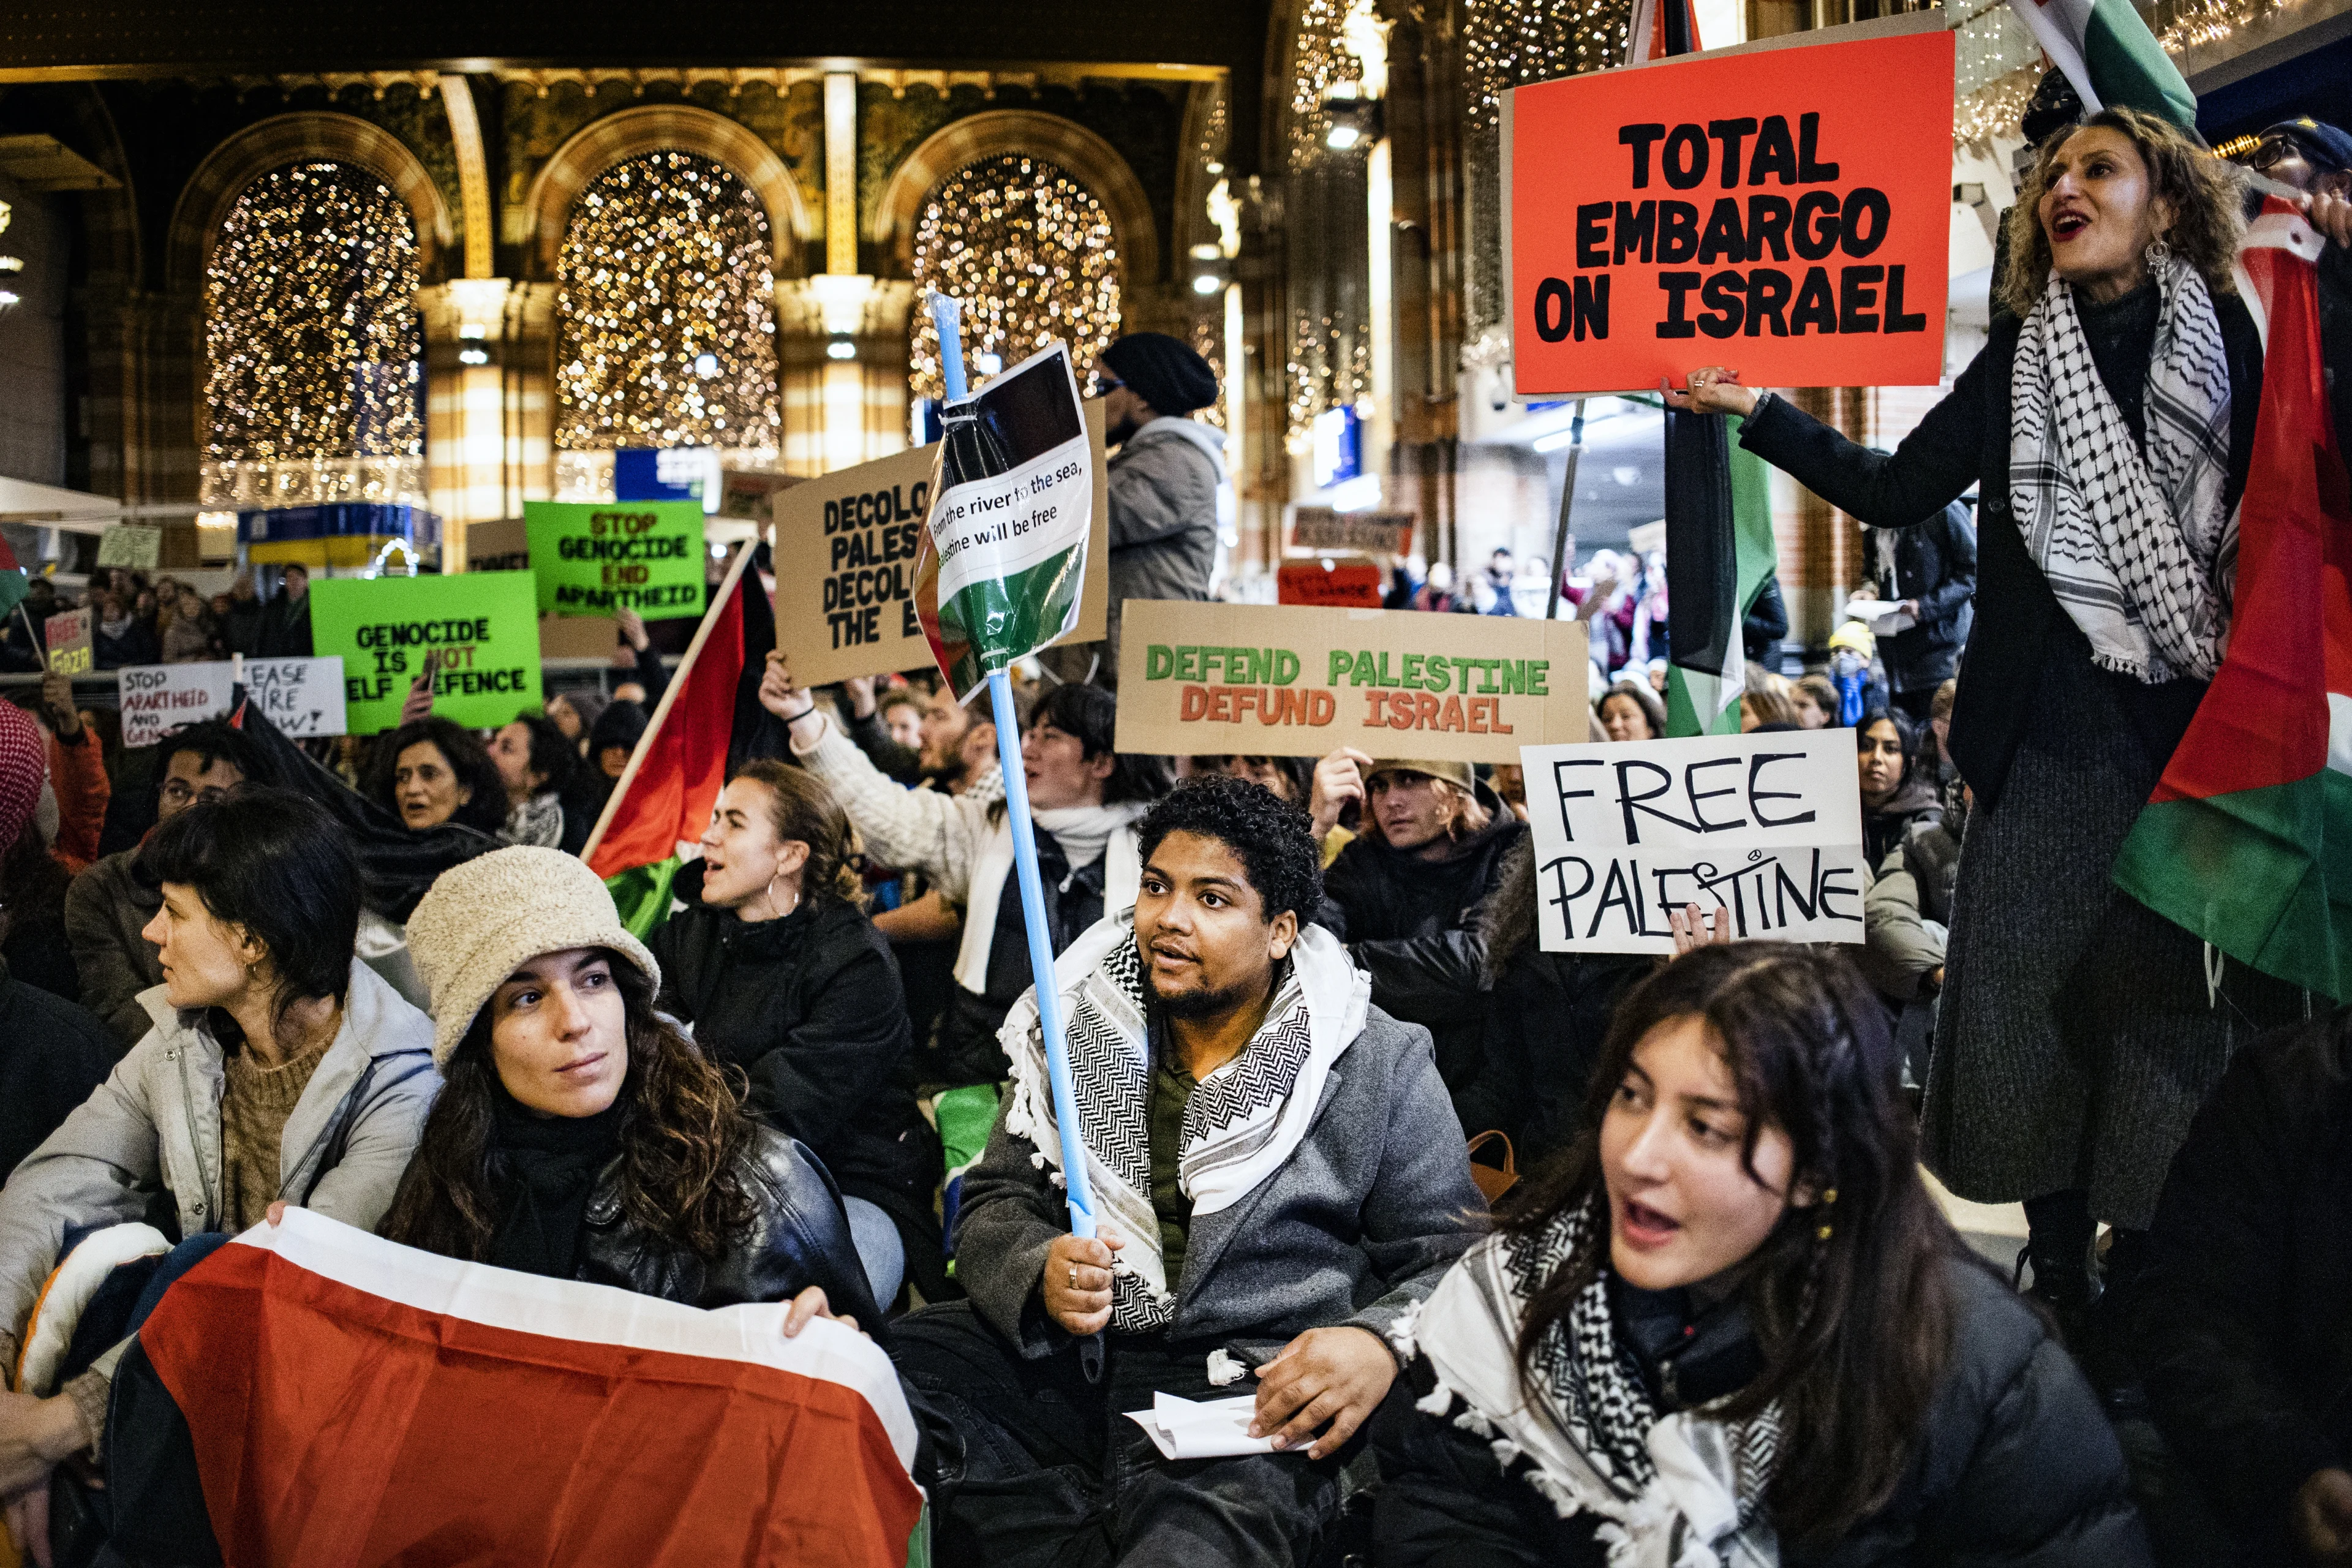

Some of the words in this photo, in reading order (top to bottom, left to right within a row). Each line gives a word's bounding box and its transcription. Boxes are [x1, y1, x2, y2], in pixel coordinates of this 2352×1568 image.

[1619, 112, 1839, 190] TOTAL
[1577, 187, 1891, 268] EMBARGO
[1534, 274, 1610, 342] ON
[1656, 265, 1926, 339] ISRAEL
[824, 481, 927, 536] DECOLO
[933, 518, 946, 540] From
[946, 505, 965, 525] the
[970, 493, 1011, 514] river
[1014, 486, 1028, 502] to
[1031, 474, 1053, 494] the
[1056, 462, 1082, 483] sea,
[590, 511, 658, 535] STOP
[974, 522, 1008, 545] will
[1012, 519, 1030, 537] be
[1032, 506, 1057, 529] free
[559, 534, 689, 560] GENOCIDE
[831, 523, 920, 571] PALES
[601, 564, 650, 585] END
[556, 584, 697, 607] APARTHEID
[45, 617, 79, 647] FREE
[356, 617, 490, 649] GENOCIDE
[827, 606, 881, 649] THE
[50, 647, 89, 674] GAZA
[243, 663, 307, 687] EASE
[374, 650, 407, 673] IS
[1145, 644, 1300, 686] DEFEND
[1327, 650, 1550, 696] PALESTINE
[126, 671, 167, 691] STOP
[345, 676, 392, 702] ELF
[123, 688, 209, 710] APARTHEID
[1180, 685, 1335, 726] DEFUND
[1362, 691, 1513, 734] ISRAEL
[130, 713, 160, 726] AND
[1553, 752, 1815, 845] FREE
[1540, 848, 1863, 940] PALESTINE
